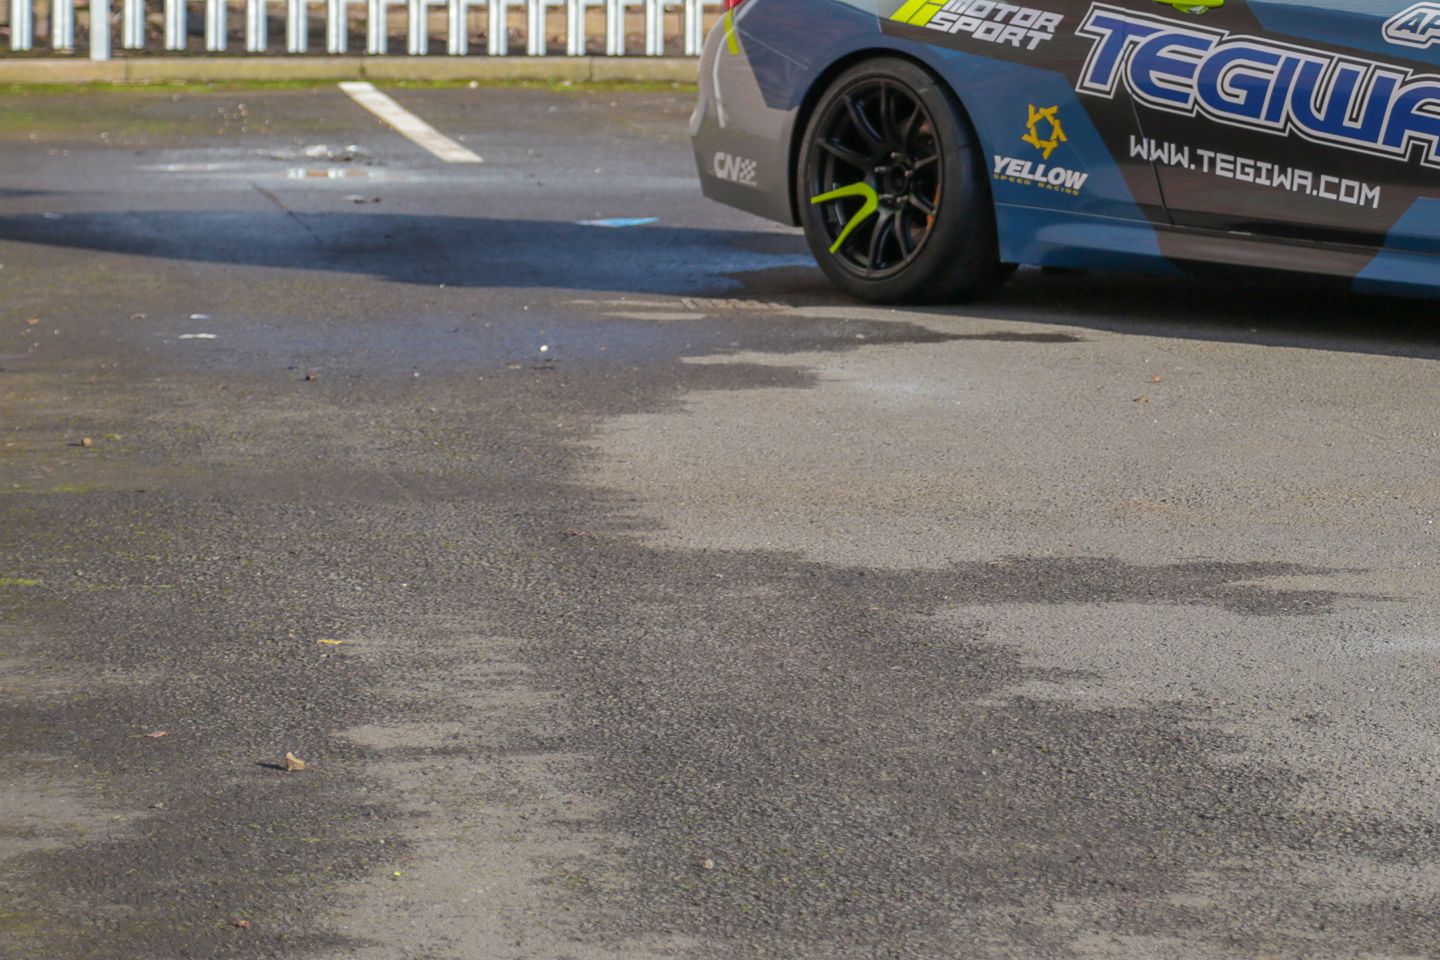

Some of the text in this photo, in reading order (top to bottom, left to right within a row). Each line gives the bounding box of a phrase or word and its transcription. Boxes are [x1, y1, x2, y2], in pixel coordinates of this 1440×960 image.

[925, 11, 1053, 50] SPORT
[993, 155, 1088, 189] YELLOW
[1129, 134, 1381, 209] WWW.TEGIWA.COM
